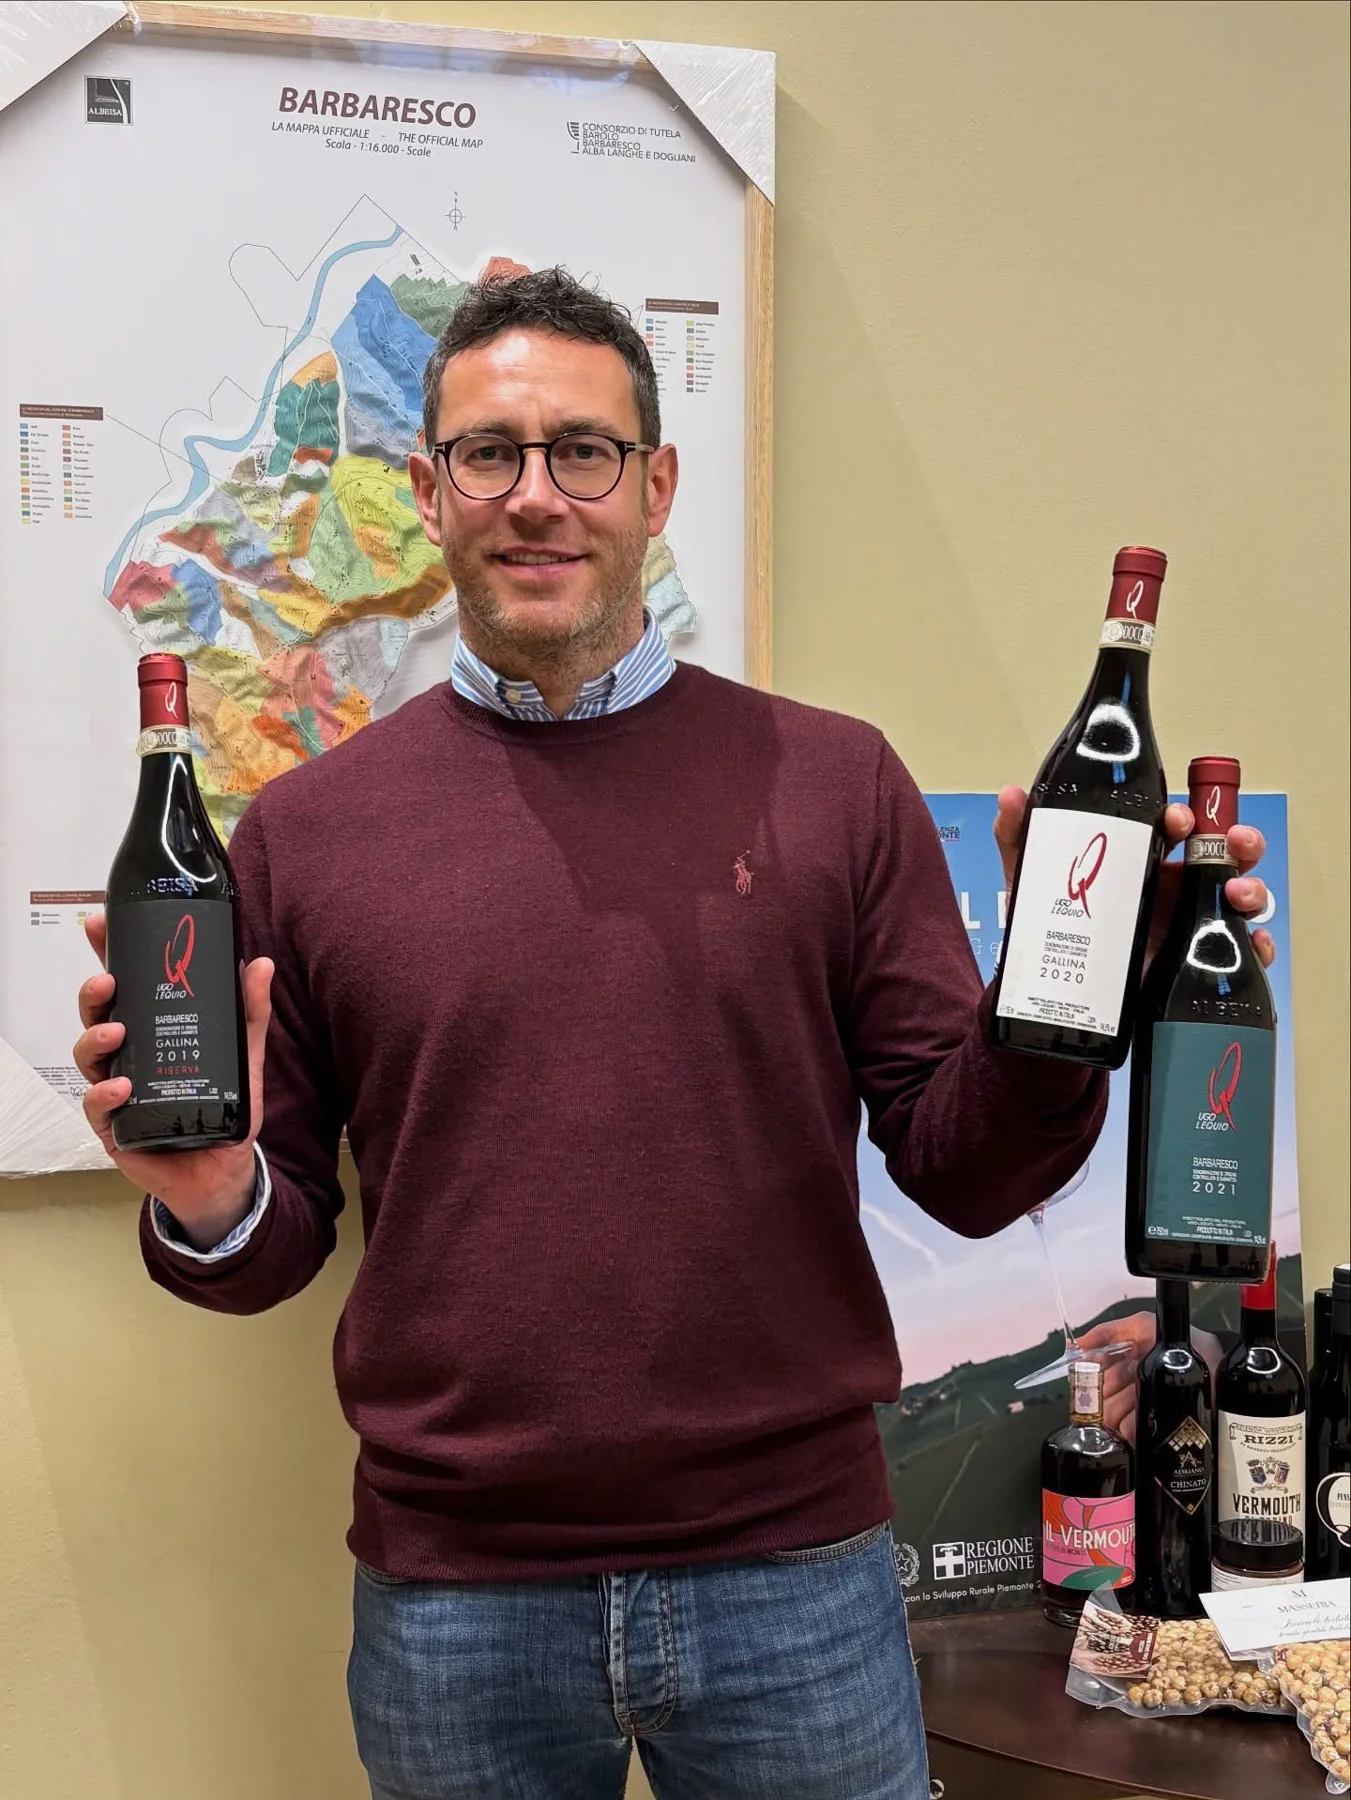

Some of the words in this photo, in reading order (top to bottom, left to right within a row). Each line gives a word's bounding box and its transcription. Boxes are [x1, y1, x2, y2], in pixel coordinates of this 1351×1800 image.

[88, 107, 122, 116] ALBEISA
[279, 87, 476, 128] BARBARESCO
[272, 122, 284, 132] LA
[286, 123, 320, 135] MAPPA
[322, 126, 370, 139] UFFICIALE
[399, 132, 416, 144] THE
[418, 134, 459, 147] OFFICIAL
[461, 138, 483, 149] MAP
[582, 123, 635, 135] CONSORZIO
[638, 127, 647, 135] DI
[650, 128, 681, 138] TUTELA
[582, 131, 619, 141] BAROLO
[325, 139, 351, 150] Scala
[360, 142, 399, 154] 1:16.000
[407, 145, 431, 157] Scale
[582, 139, 641, 150] BARBARESCO
[582, 147, 605, 156] ALBA
[607, 149, 644, 159] LANGHE
[646, 151, 651, 159] E
[653, 152, 696, 162] DOGLIANI
[1055, 898, 1072, 908] UGO
[1046, 931, 1091, 946] BARBARESCO
[1042, 954, 1086, 970] GALLINA
[1040, 967, 1084, 984] 2020
[156, 983, 174, 992] UGO
[155, 1013, 199, 1025] BARBARESCO
[156, 1038, 199, 1048] GALLINA
[156, 1050, 200, 1062] 2019
[157, 1066, 200, 1075] RISERVA
[1198, 1112, 1217, 1121] UGO
[1193, 1157, 1238, 1170] BARBARESCO
[1192, 1181, 1235, 1195] 2021
[1244, 1434, 1294, 1445] RIZZI
[1174, 1466, 1204, 1475] ADRIANO
[1170, 1478, 1206, 1488] CHINATO
[1232, 1493, 1301, 1515] VERMOUTH
[1045, 1520, 1055, 1542] IL
[966, 1537, 1034, 1559] REGIONE
[967, 1555, 1035, 1576] PIEMONTE
[905, 1595, 920, 1603] con
[922, 1592, 931, 1601] lo
[933, 1589, 967, 1601] Sviluppo
[969, 1586, 995, 1595] Rurale
[997, 1582, 1034, 1592] Piemonte
[1277, 1600, 1336, 1613] MASSERIA
